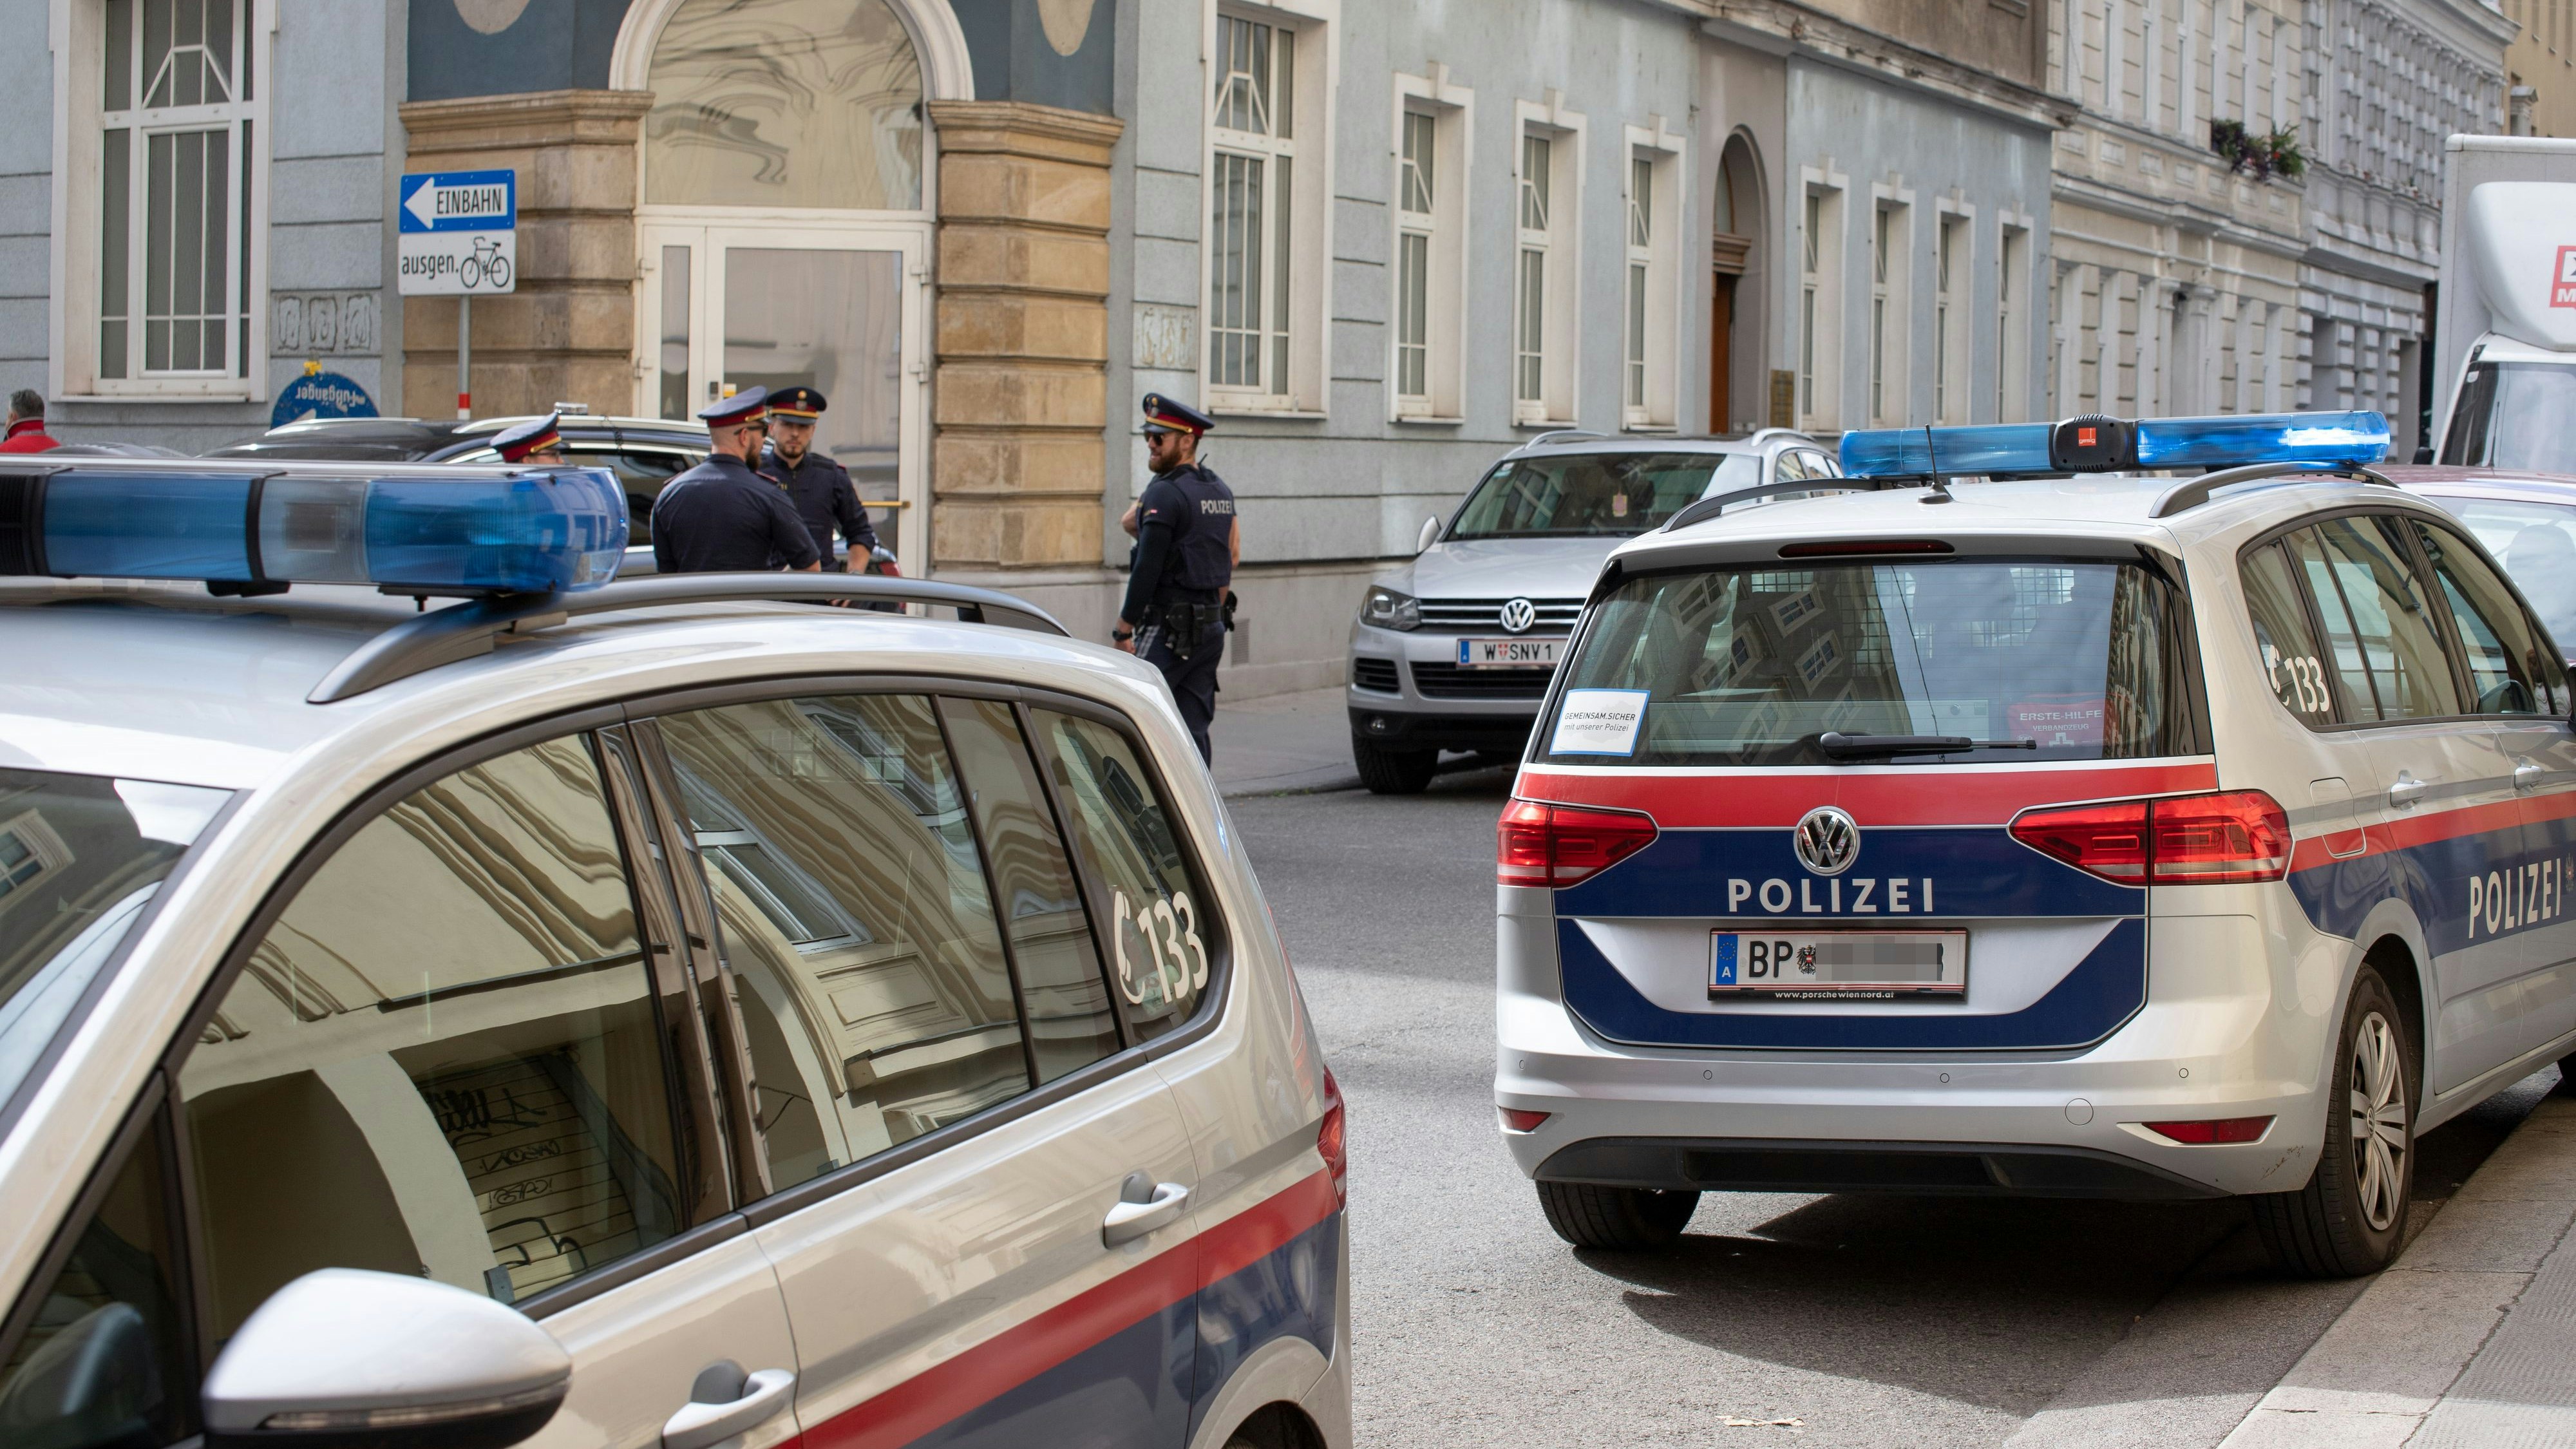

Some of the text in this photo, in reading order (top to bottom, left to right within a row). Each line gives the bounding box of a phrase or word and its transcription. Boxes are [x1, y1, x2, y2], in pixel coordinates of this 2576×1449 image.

[437, 188, 501, 214] EINBAHN
[402, 255, 459, 279] ausgen.
[295, 384, 356, 407] Fußgänger
[1484, 644, 1496, 660] W
[2284, 656, 2330, 712] 133
[1565, 712, 1636, 721] GEMEINSAM.SICHER
[2020, 710, 2103, 721] ERSTE-HILFE
[2032, 723, 2089, 732] VERBANDZEUG
[1728, 878, 1933, 913] POLIZEI
[2468, 858, 2561, 939] POLIZEI
[1137, 891, 1208, 1003] 133
[1721, 967, 1731, 978] A
[1748, 940, 1794, 978] BP
